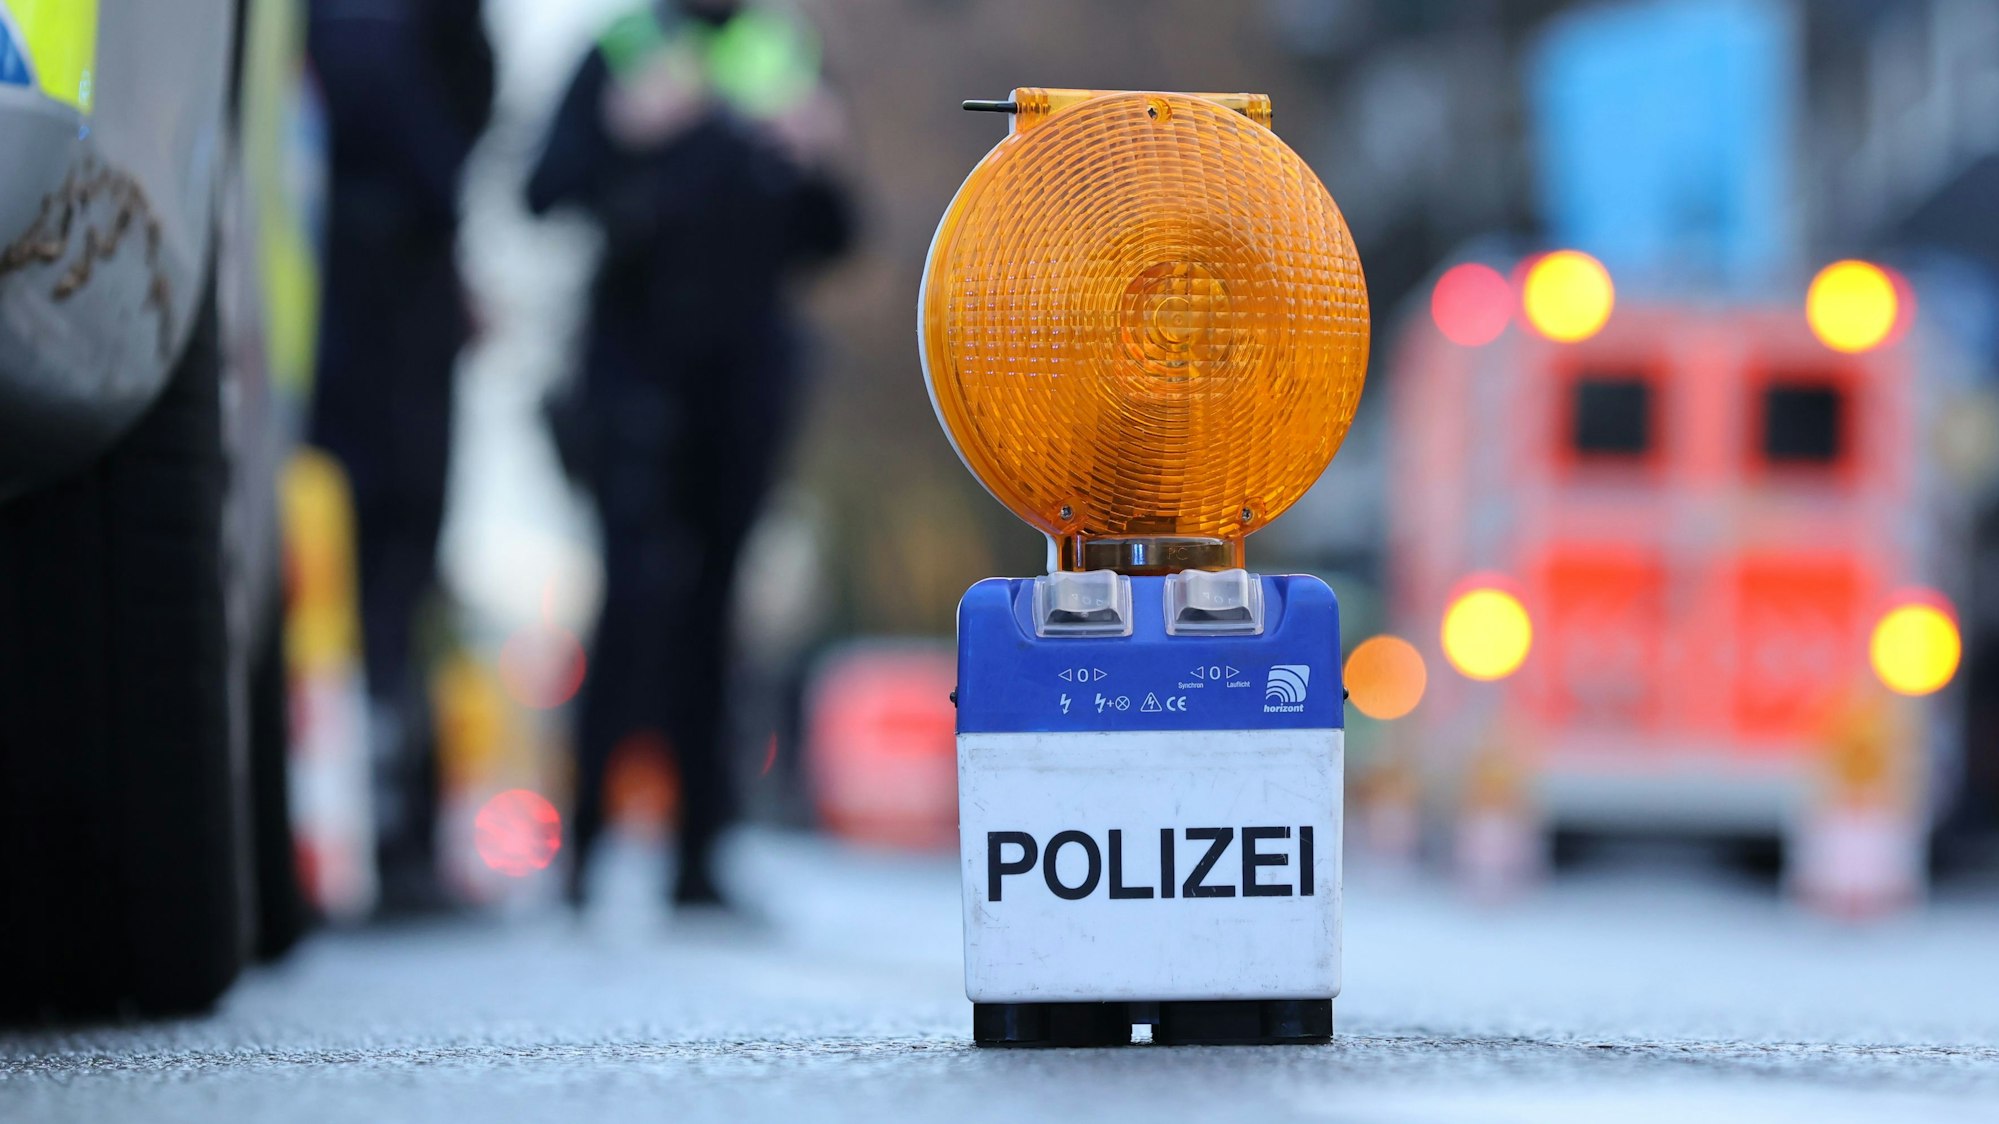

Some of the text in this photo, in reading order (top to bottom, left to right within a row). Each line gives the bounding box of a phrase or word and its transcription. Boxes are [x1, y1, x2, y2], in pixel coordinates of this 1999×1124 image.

[1178, 681, 1204, 690] Synchron
[1166, 696, 1187, 711] CE
[1263, 703, 1304, 713] horizont
[987, 826, 1315, 902] POLIZEI
